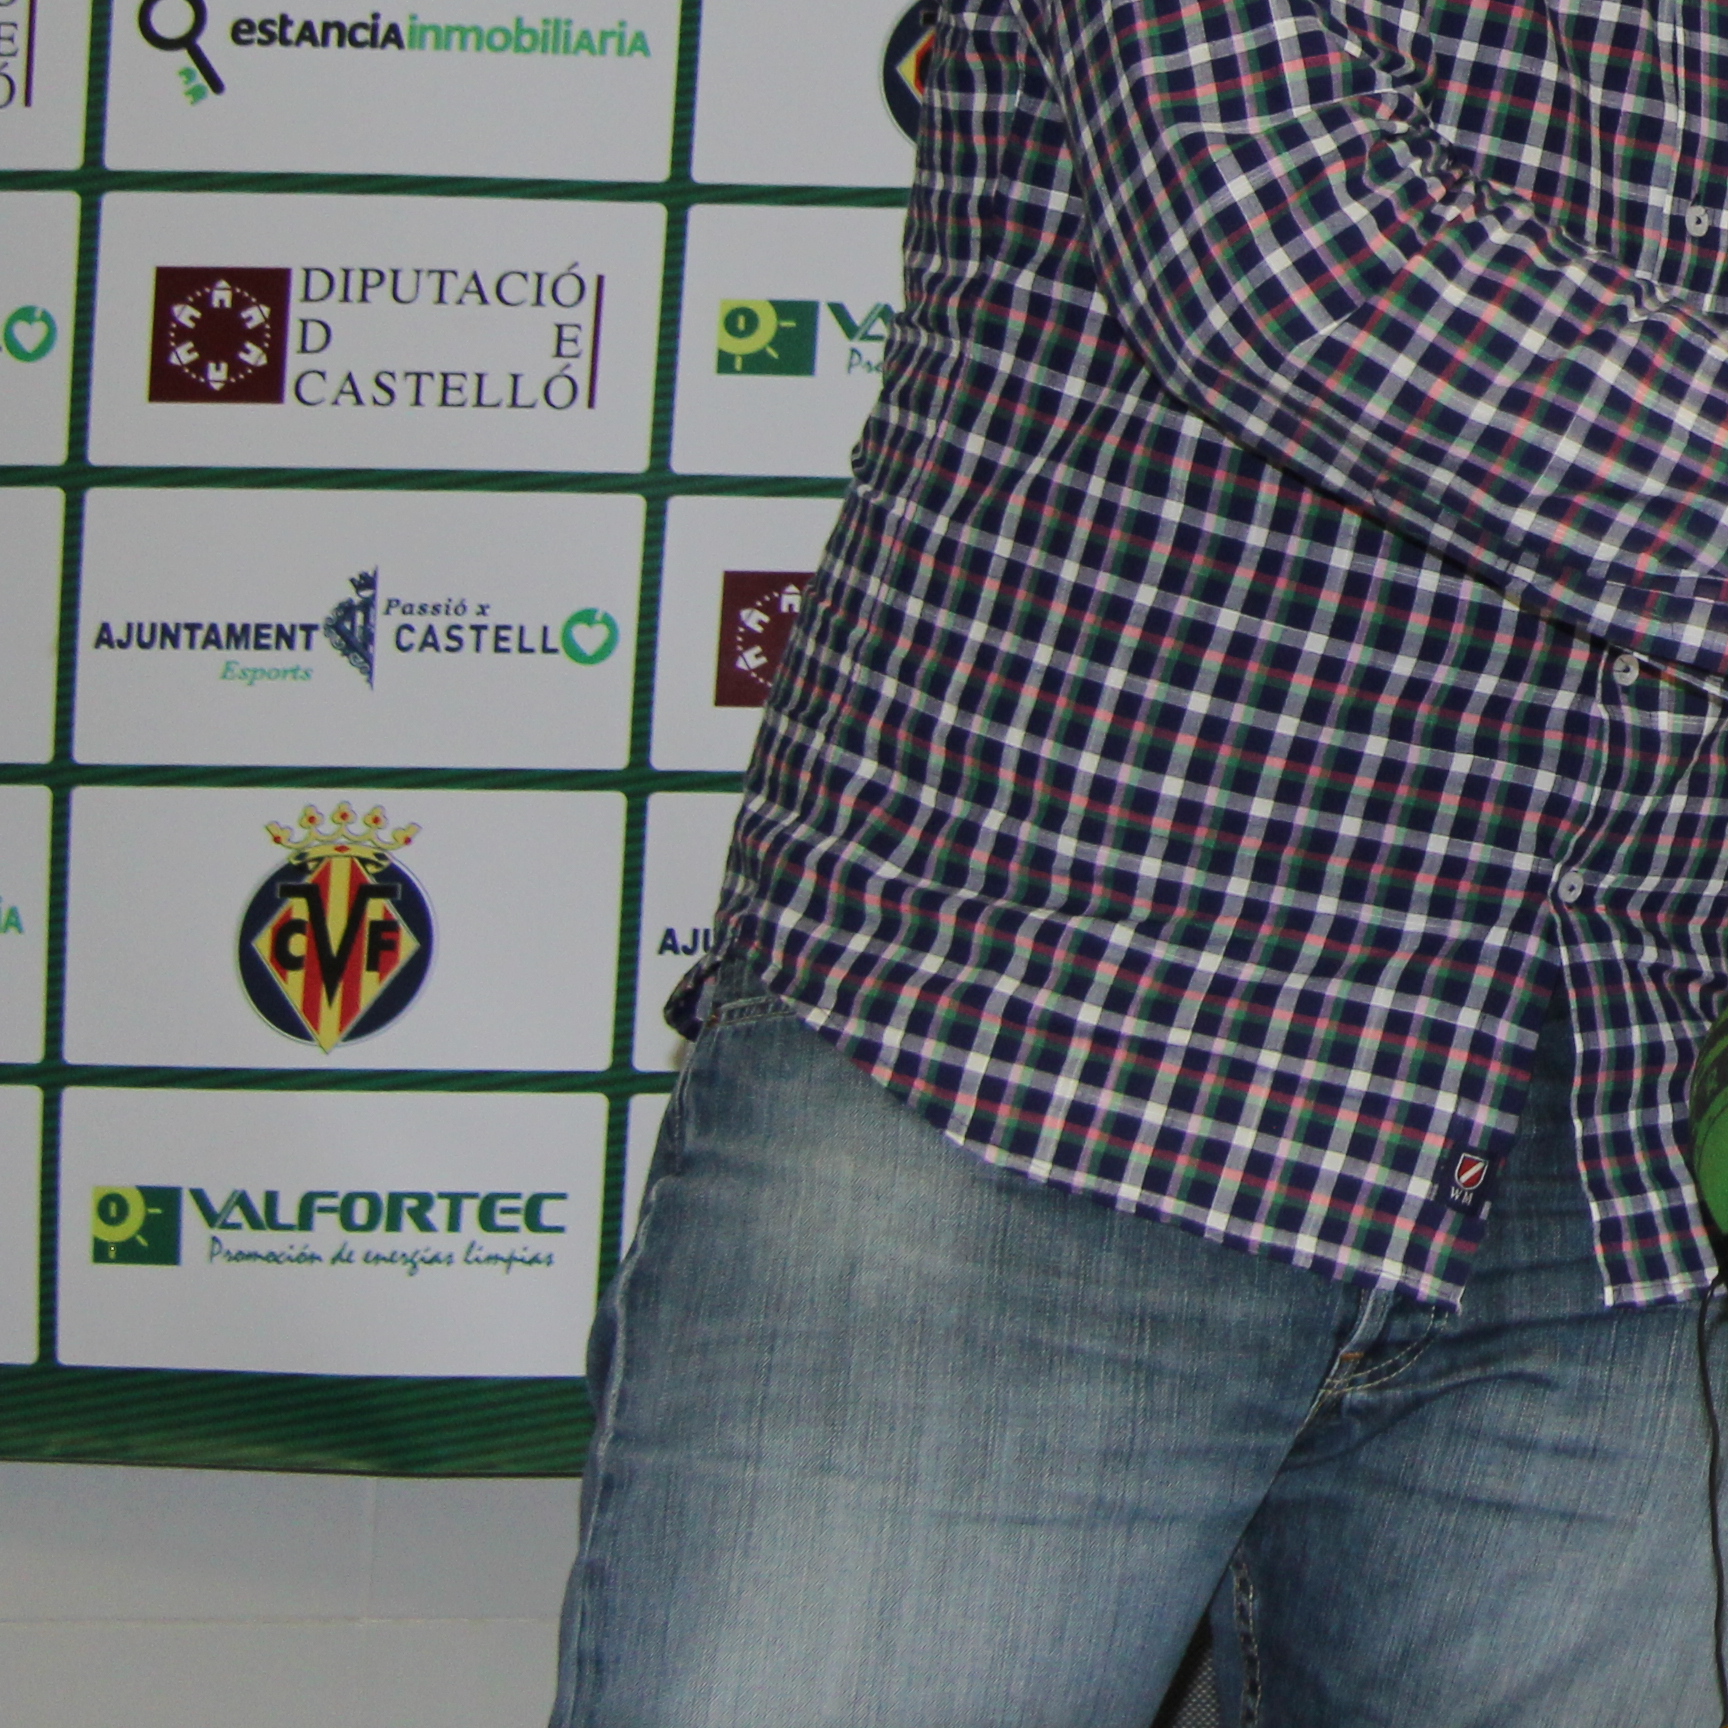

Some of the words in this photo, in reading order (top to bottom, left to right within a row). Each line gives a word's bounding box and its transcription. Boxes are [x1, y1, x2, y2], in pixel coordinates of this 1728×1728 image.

[300, 262, 586, 308] DIPUTACIÓ
[294, 364, 578, 410] CASTELLÓ
[383, 598, 468, 616] Passió
[94, 622, 320, 651] AJUNTAMENT
[219, 661, 313, 686] Esports
[189, 1188, 568, 1233] VALFORTEC
[209, 1235, 323, 1263] Promoción
